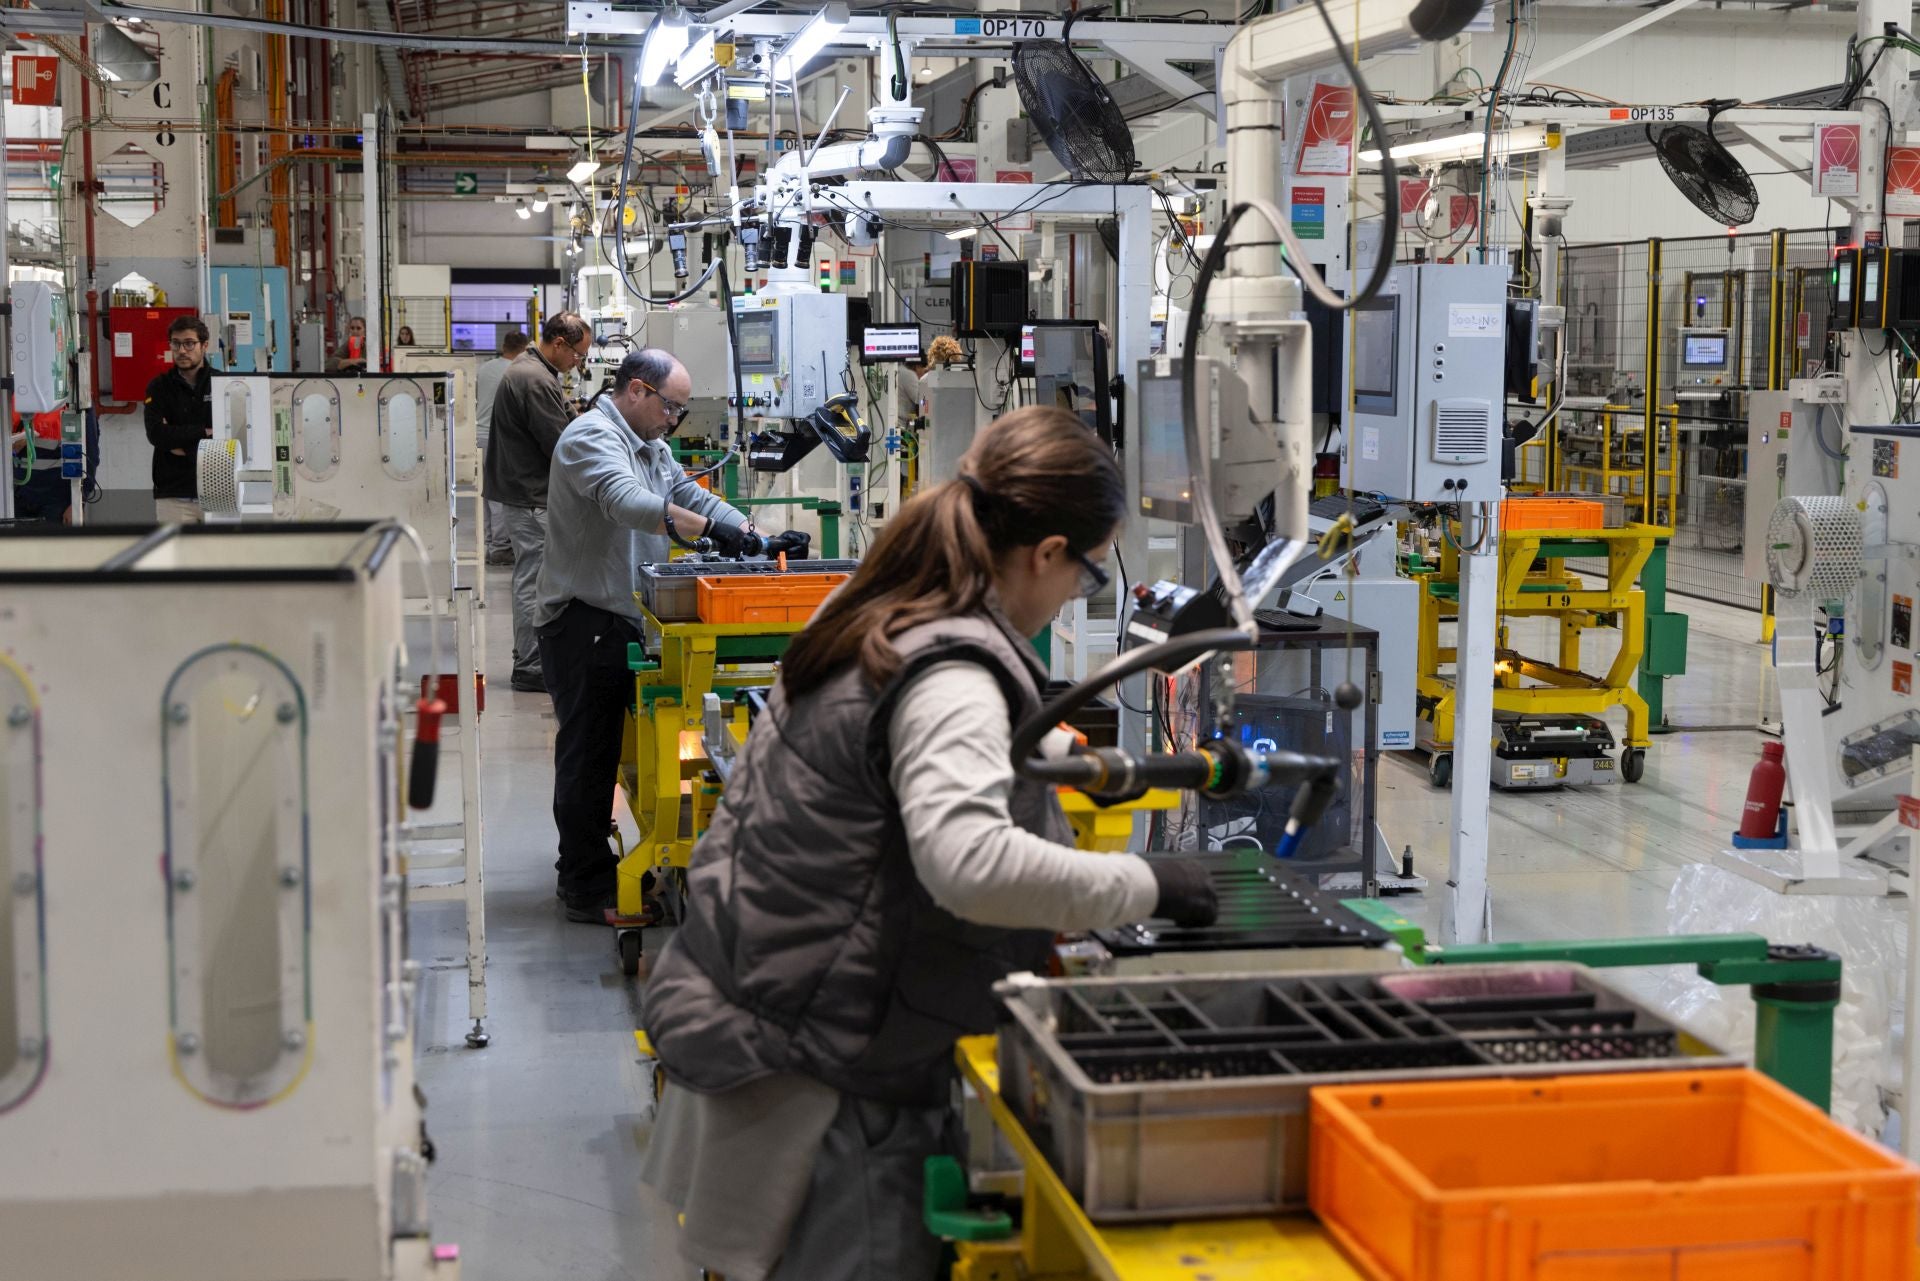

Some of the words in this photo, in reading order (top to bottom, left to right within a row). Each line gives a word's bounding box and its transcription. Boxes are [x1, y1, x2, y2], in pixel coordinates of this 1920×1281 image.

[983, 19, 1045, 37] OP170
[1631, 108, 1674, 120] OP135
[1594, 760, 1614, 769] 2443
